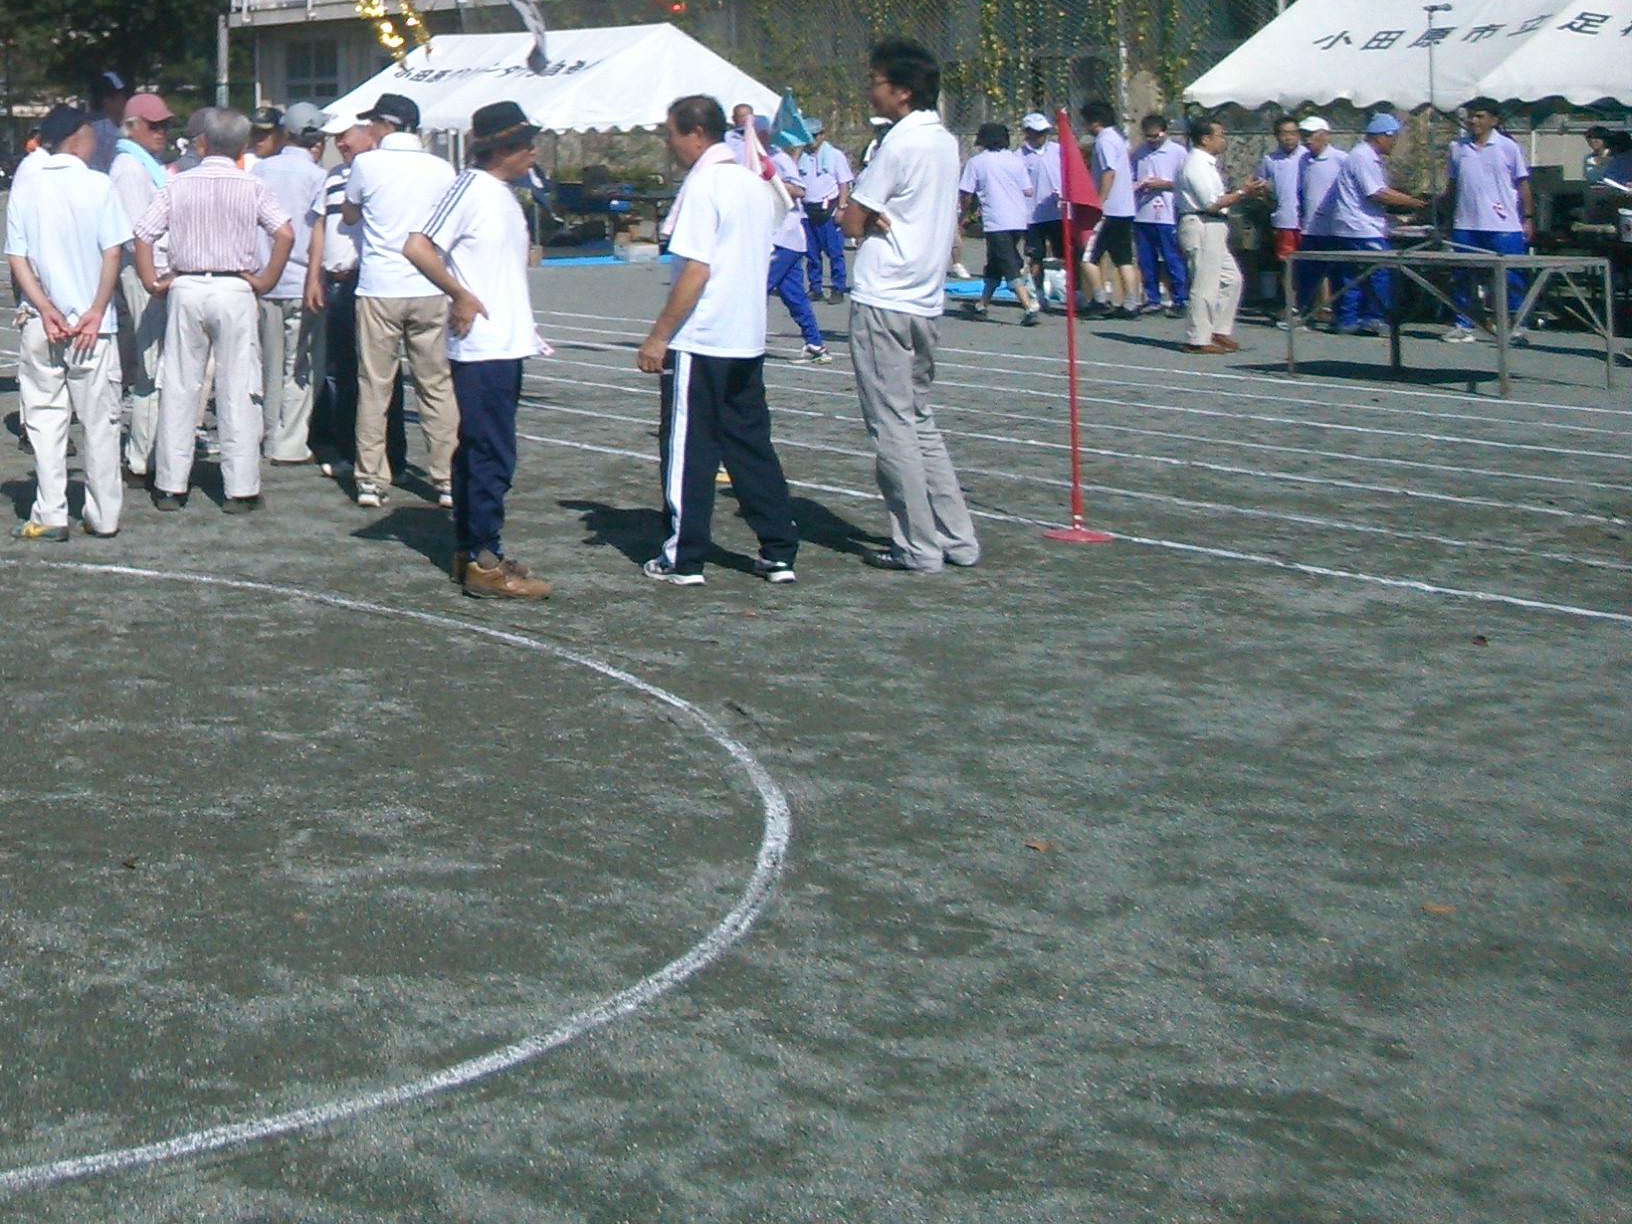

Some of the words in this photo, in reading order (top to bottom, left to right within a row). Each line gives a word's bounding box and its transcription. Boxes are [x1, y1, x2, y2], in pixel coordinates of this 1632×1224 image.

[1312, 10, 1632, 51] 小田原市立足
